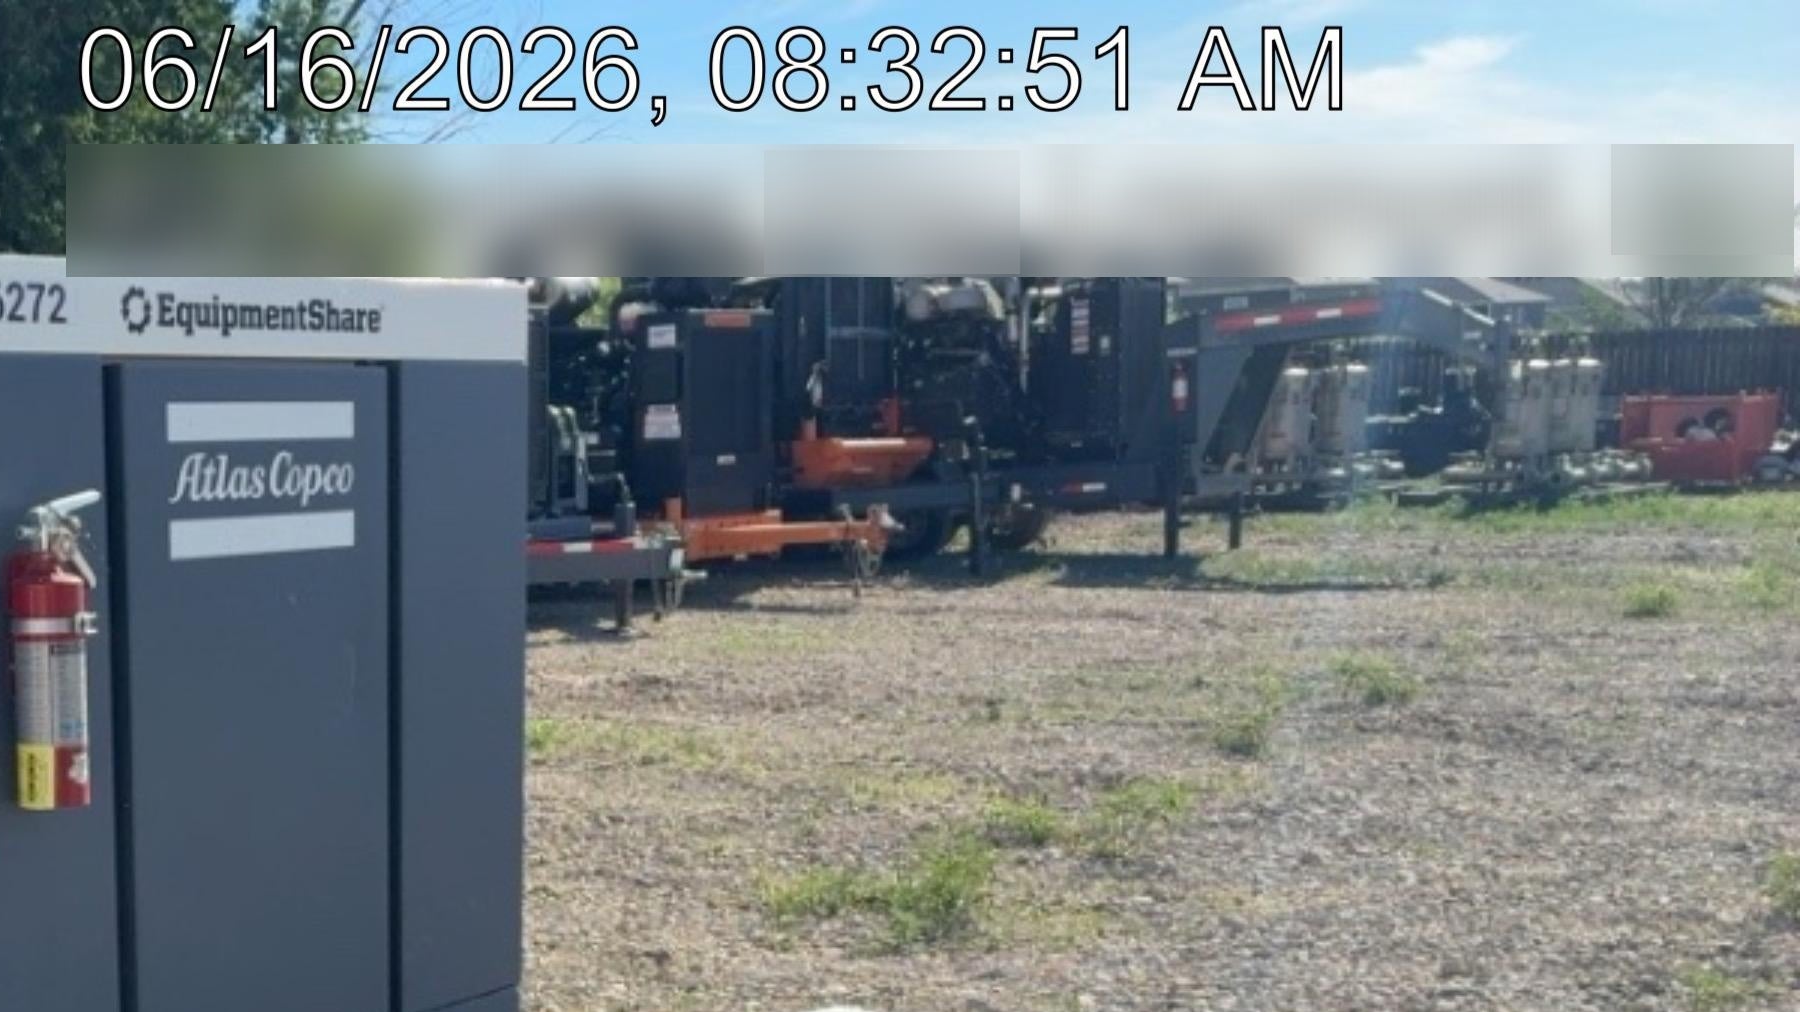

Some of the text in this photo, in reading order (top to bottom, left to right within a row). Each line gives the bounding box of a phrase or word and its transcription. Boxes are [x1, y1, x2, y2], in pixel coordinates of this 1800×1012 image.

[156, 293, 382, 336] EquipmentShare
[169, 450, 354, 506] Atlas Copco
